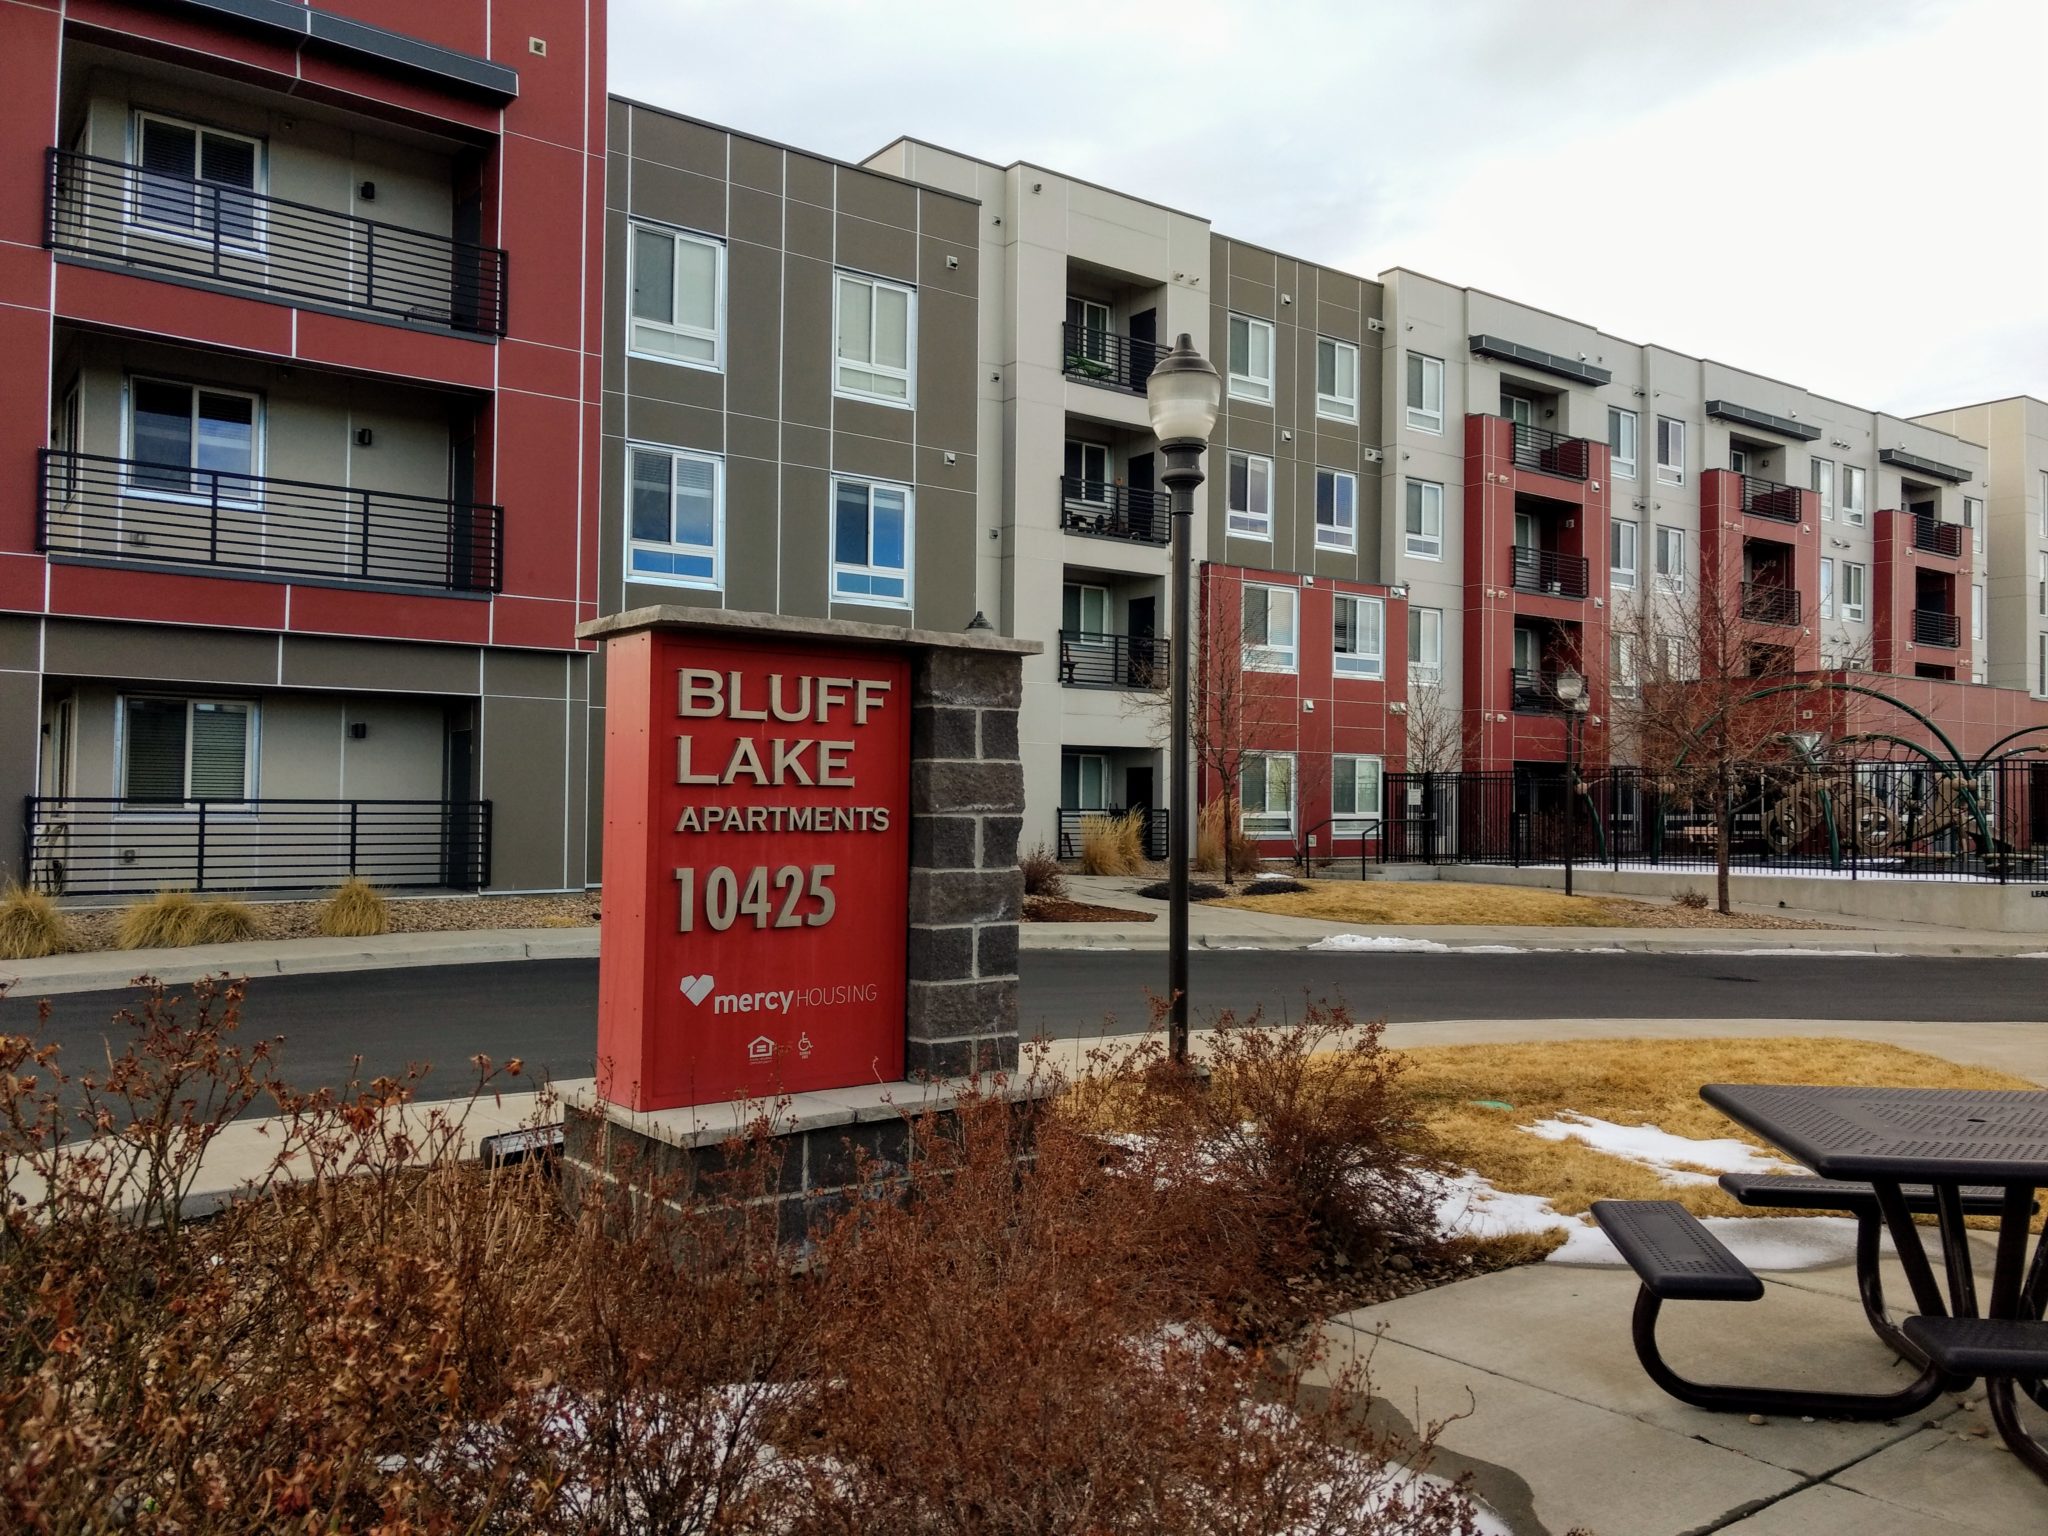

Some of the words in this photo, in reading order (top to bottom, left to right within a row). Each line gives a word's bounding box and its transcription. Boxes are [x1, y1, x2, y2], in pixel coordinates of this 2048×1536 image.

[678, 668, 891, 724] BLUFF
[677, 735, 855, 787] LAKE
[675, 806, 890, 832] APARTMENTS
[675, 865, 836, 932] 10425
[714, 990, 794, 1014] mercy
[797, 984, 877, 1007] HOUSING
